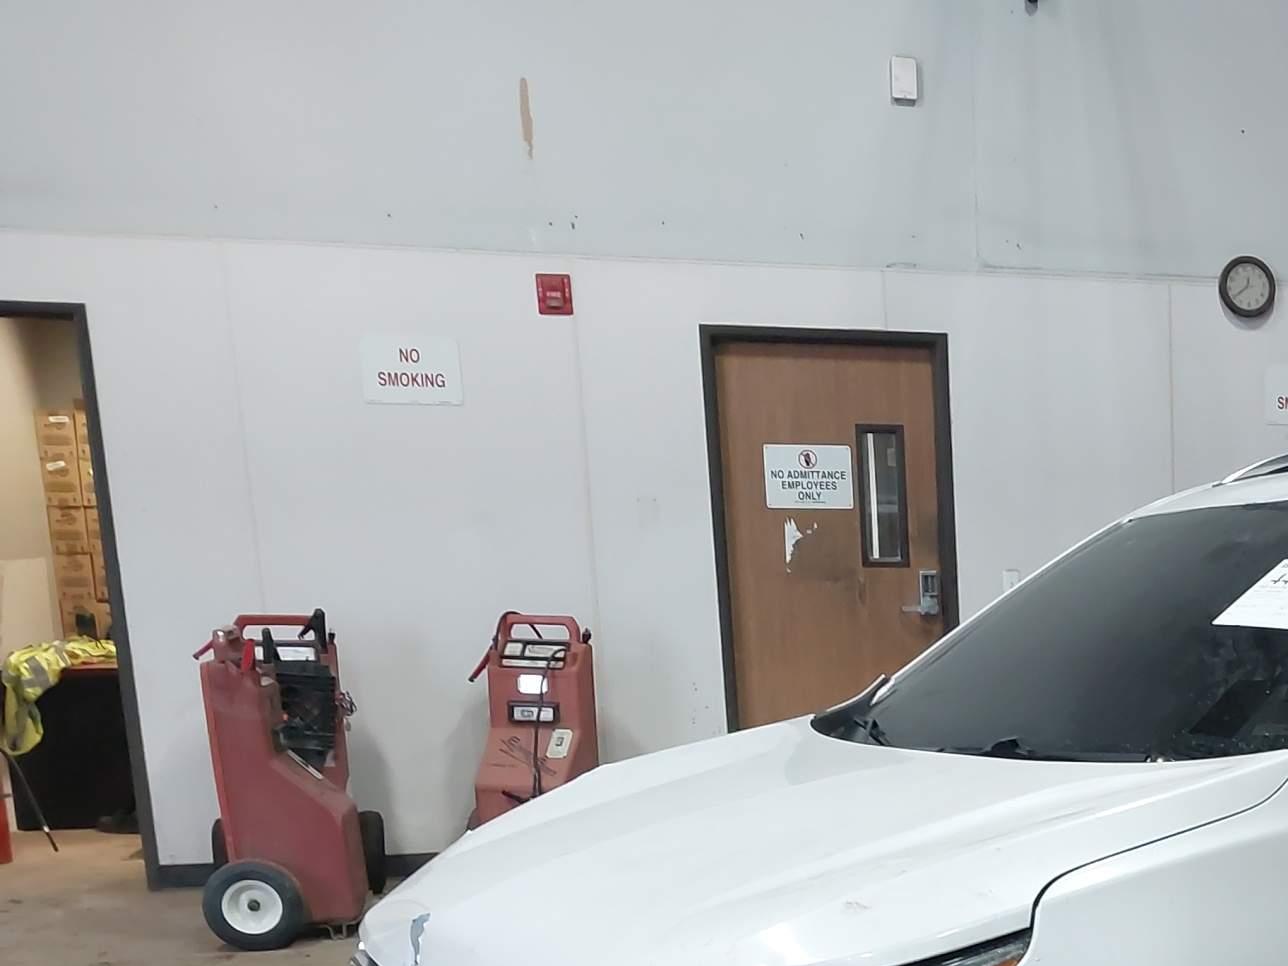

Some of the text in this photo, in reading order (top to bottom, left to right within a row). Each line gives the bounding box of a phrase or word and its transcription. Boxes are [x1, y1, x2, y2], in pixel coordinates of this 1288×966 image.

[398, 347, 420, 363] NO
[377, 371, 446, 388] SMOKING
[770, 469, 847, 480] NO ADMITTANCE
[781, 480, 838, 491] EMPLOYEES
[797, 491, 822, 501] ONLY
